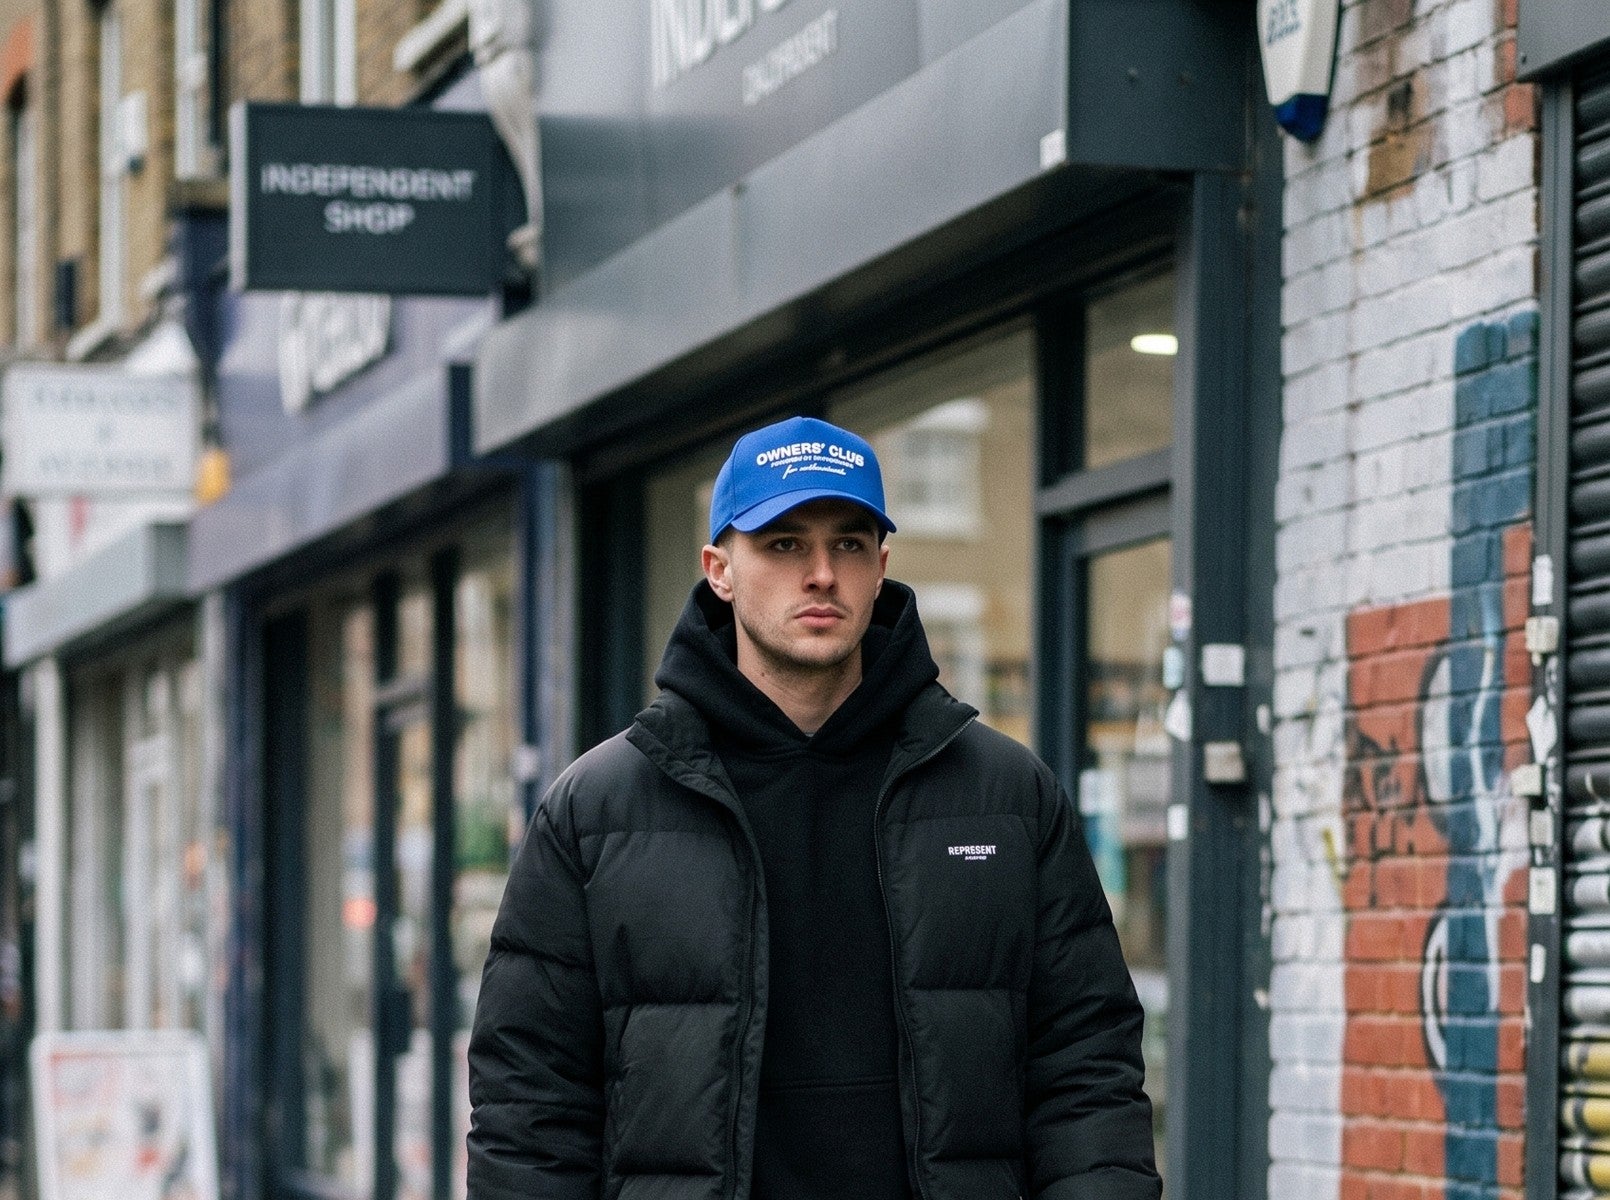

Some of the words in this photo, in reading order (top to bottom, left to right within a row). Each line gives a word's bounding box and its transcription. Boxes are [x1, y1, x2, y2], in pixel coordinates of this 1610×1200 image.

[261, 163, 476, 200] INDEPENDENT
[324, 200, 415, 234] SHOP
[828, 444, 865, 467] CLUB
[948, 845, 996, 855] REPRESENT
